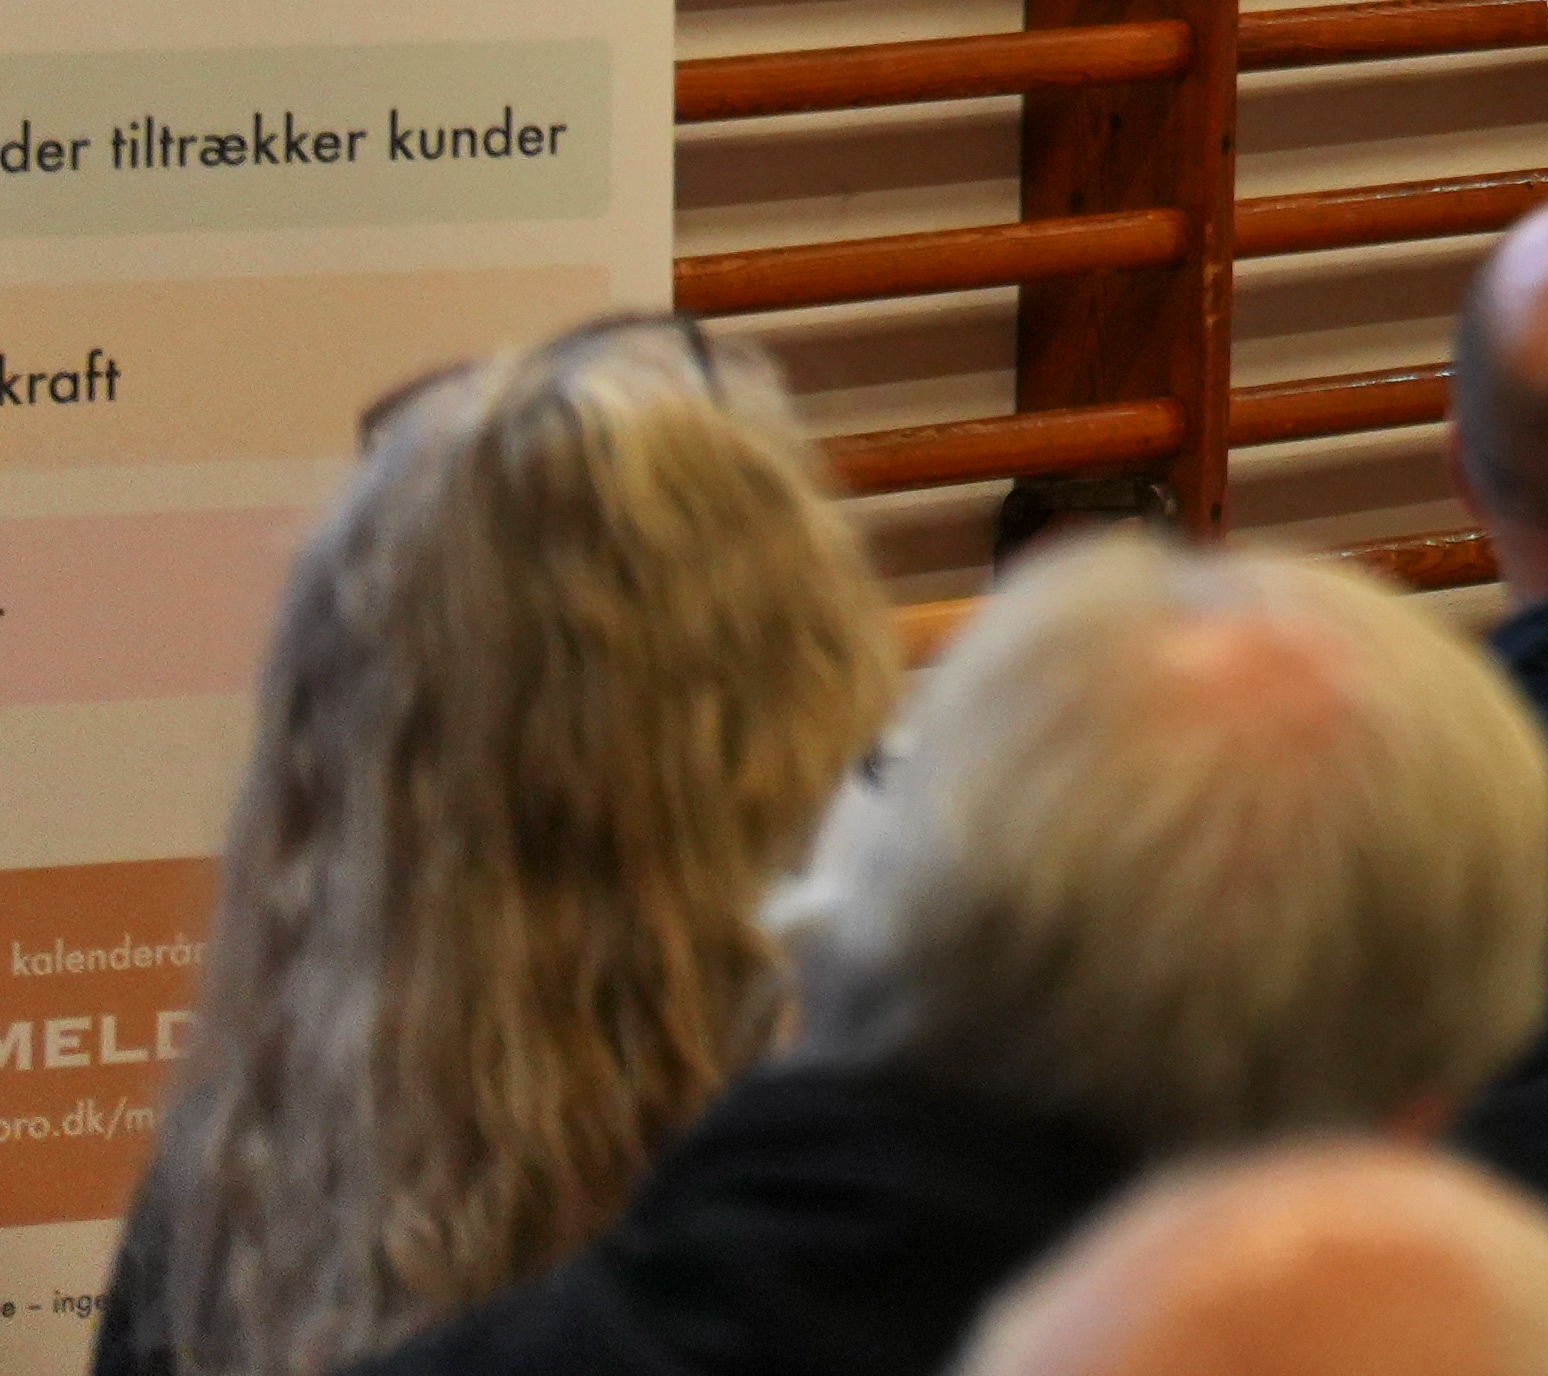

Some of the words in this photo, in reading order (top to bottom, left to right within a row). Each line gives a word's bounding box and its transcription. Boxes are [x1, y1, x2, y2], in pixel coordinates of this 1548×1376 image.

[1, 119, 91, 174] der
[112, 110, 367, 169] tiltrækker
[389, 105, 567, 157] kunder
[0, 347, 122, 406] kraft
